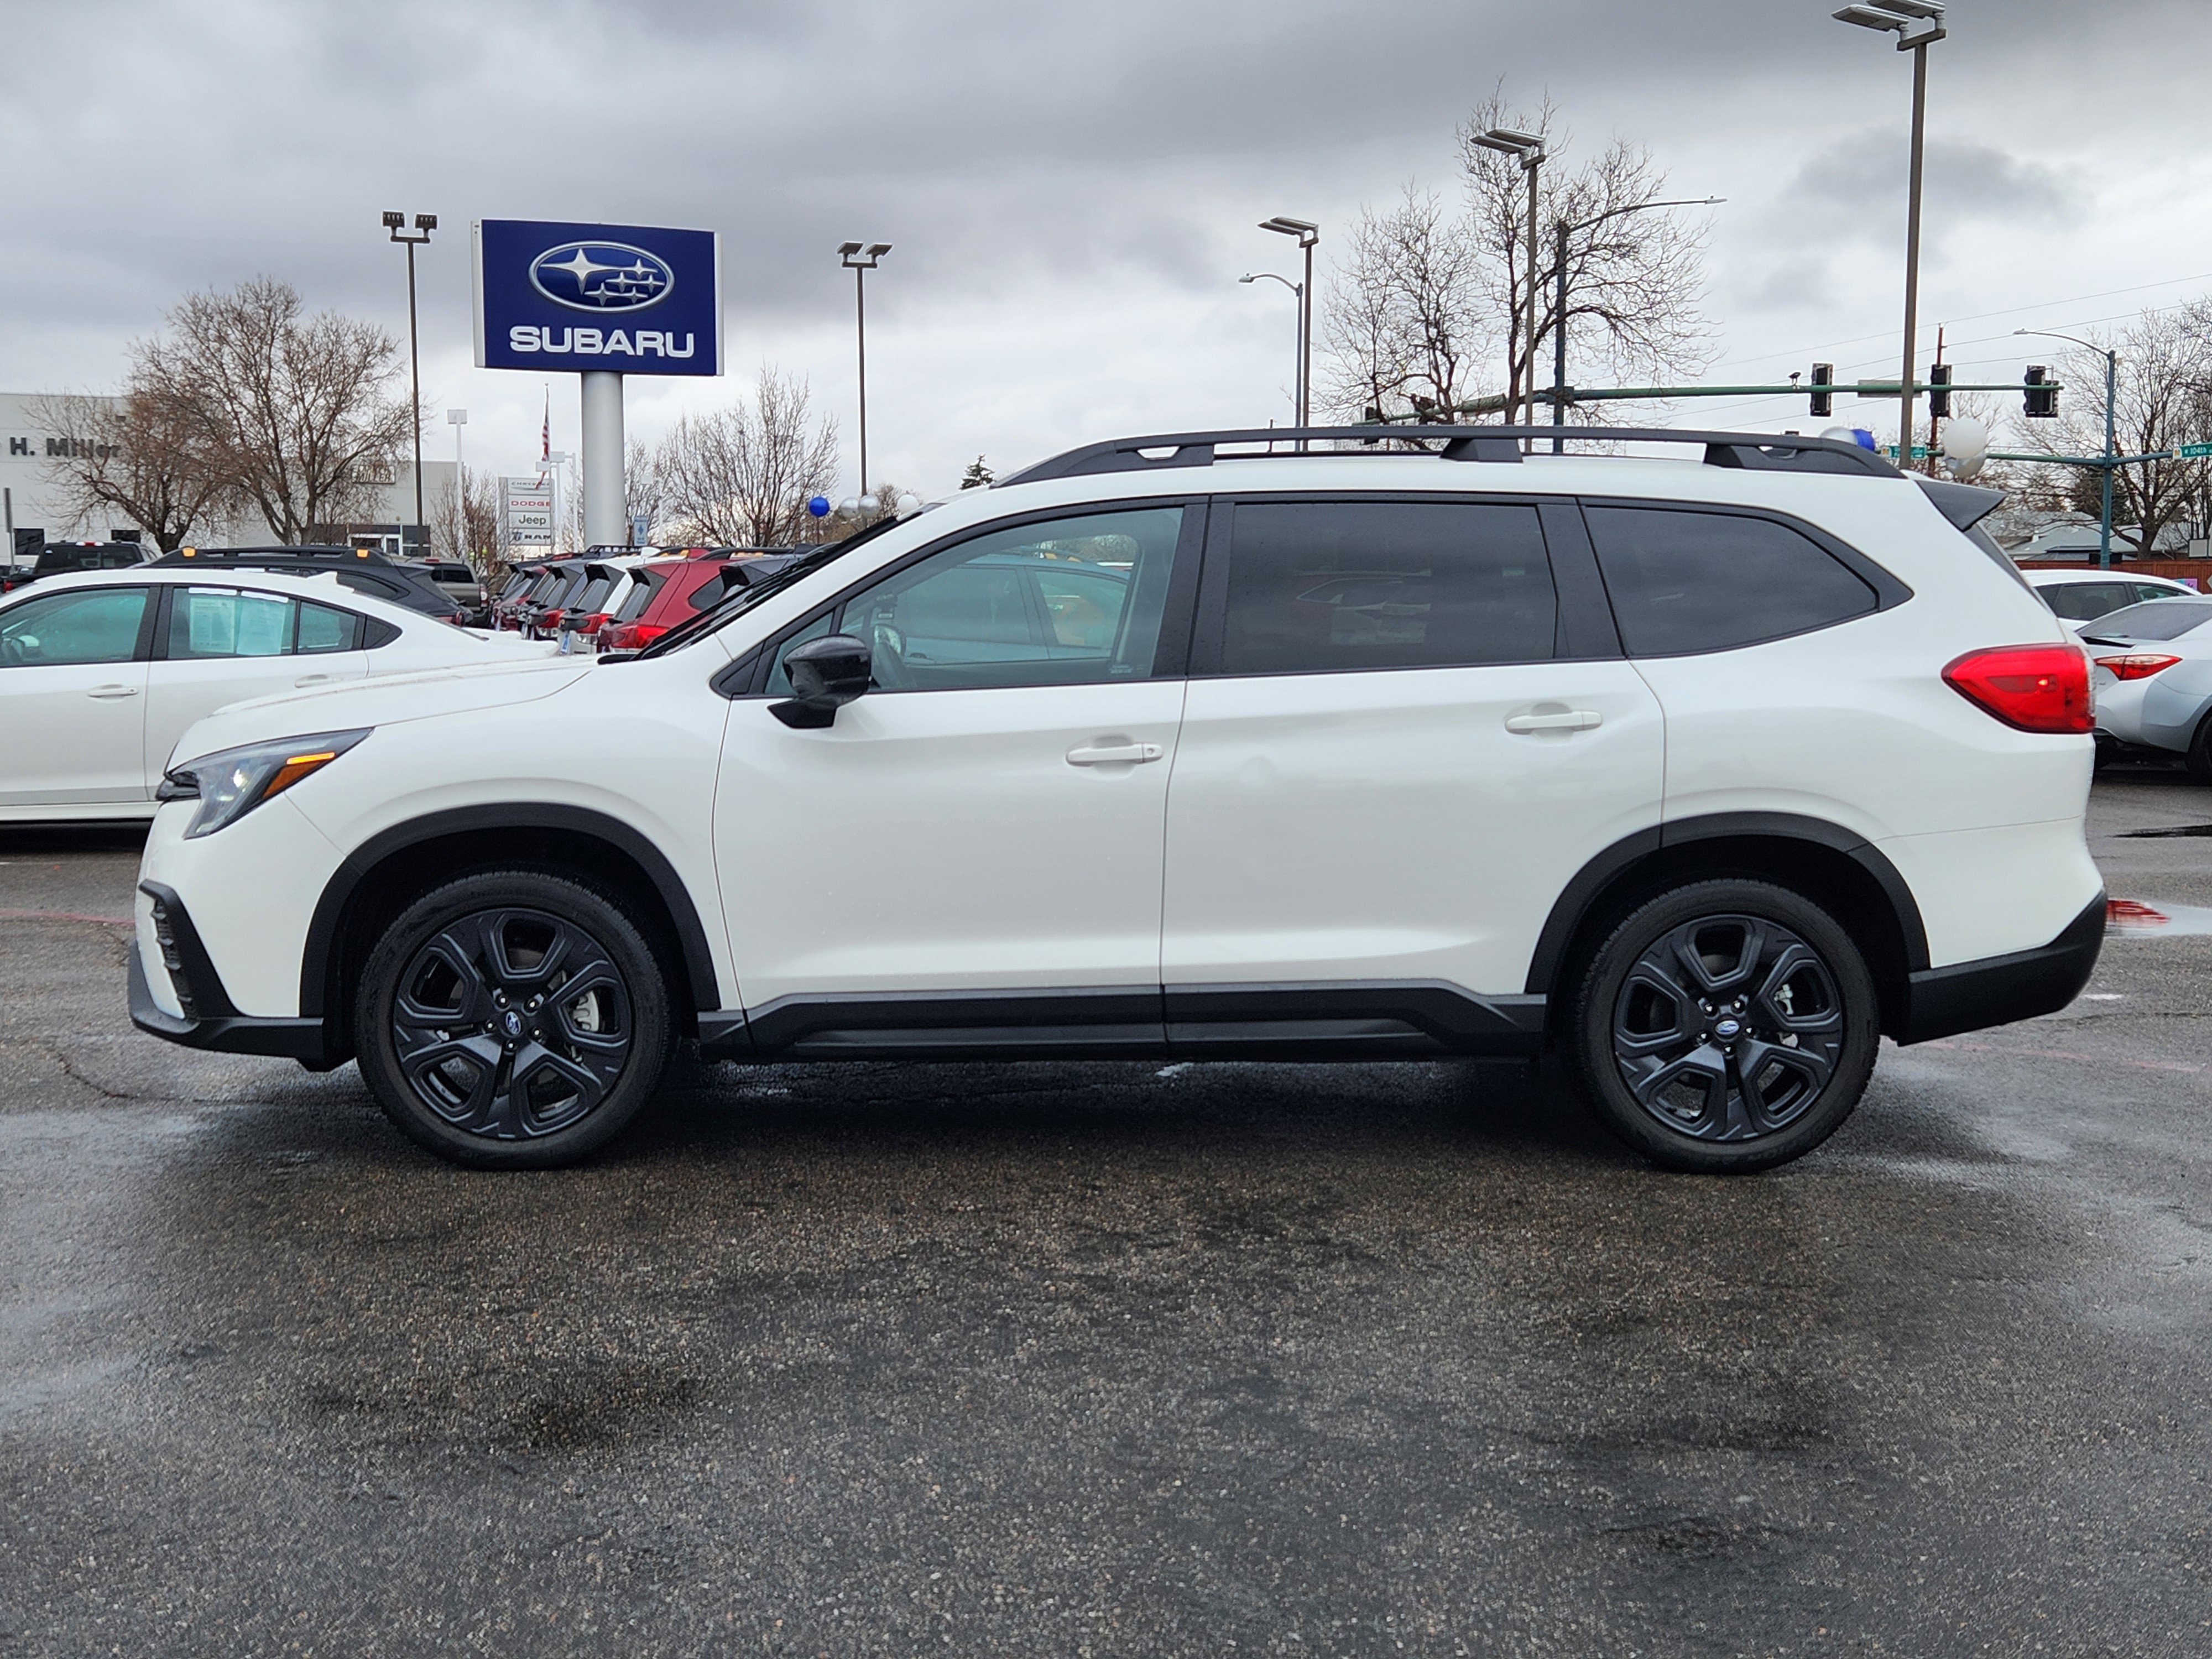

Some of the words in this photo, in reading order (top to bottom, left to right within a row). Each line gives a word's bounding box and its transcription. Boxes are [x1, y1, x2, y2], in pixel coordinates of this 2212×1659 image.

[510, 326, 695, 358] SUBARU
[10, 437, 35, 456] H.
[519, 514, 546, 526] Jeep
